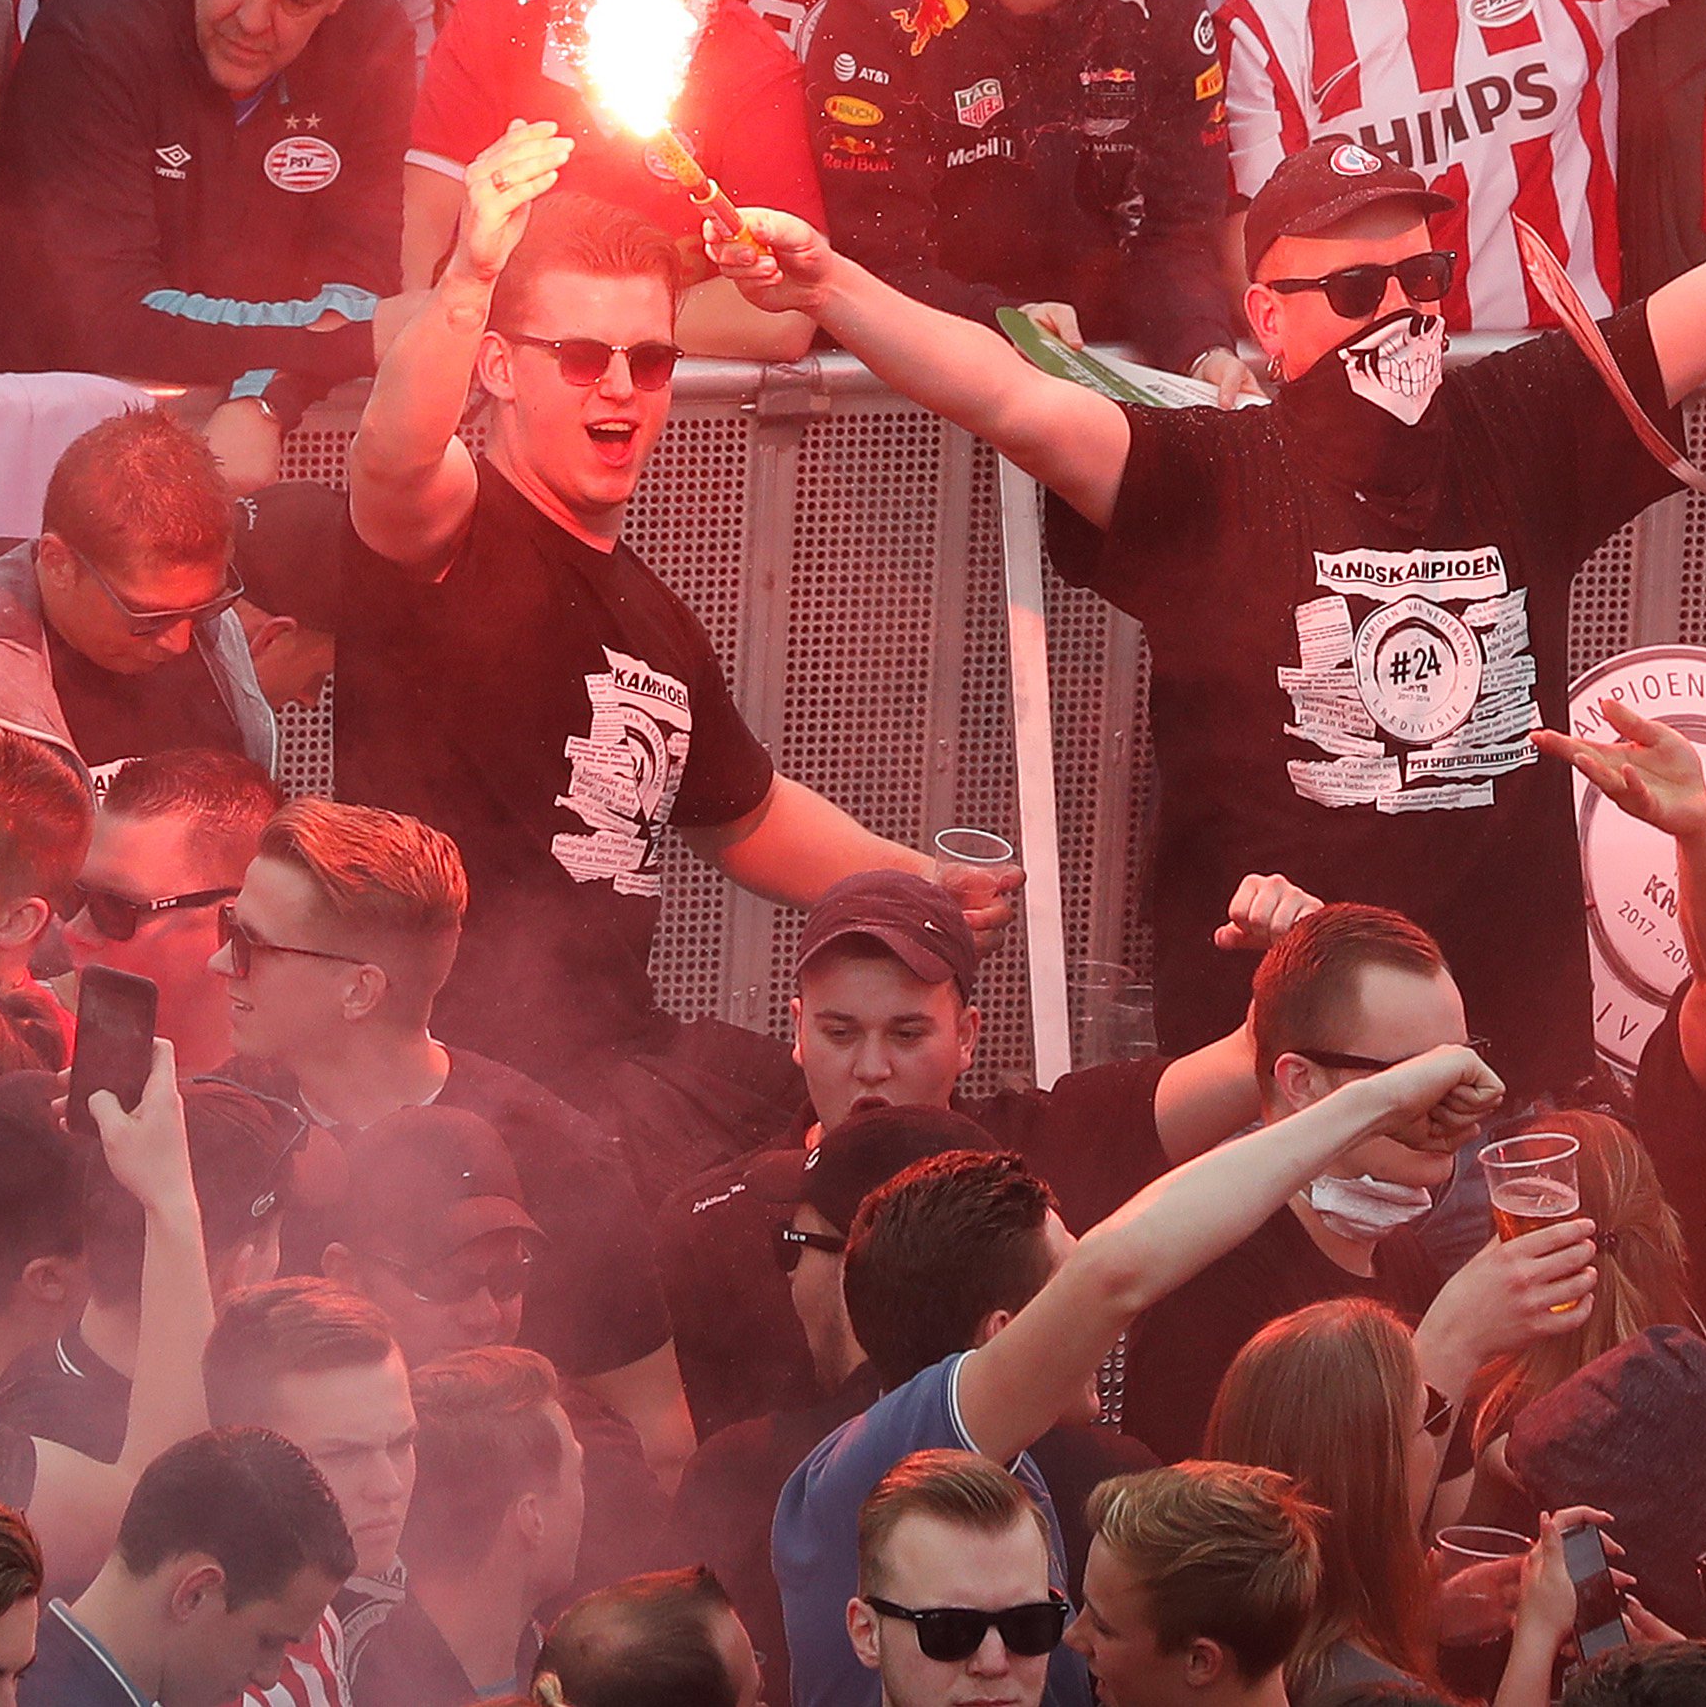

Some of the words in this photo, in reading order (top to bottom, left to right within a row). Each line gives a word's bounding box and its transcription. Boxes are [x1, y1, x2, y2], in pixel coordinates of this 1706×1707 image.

[858, 67, 890, 85] AT&T
[961, 82, 998, 106] TAG
[960, 97, 1002, 125] HEUER
[289, 154, 314, 171] PSV
[946, 138, 999, 168] Mobil
[1362, 610, 1400, 657] KAMPIOEN
[1425, 609, 1473, 667] NEDERLAND
[1389, 644, 1442, 685] #24
[1618, 901, 1654, 937] 2017
